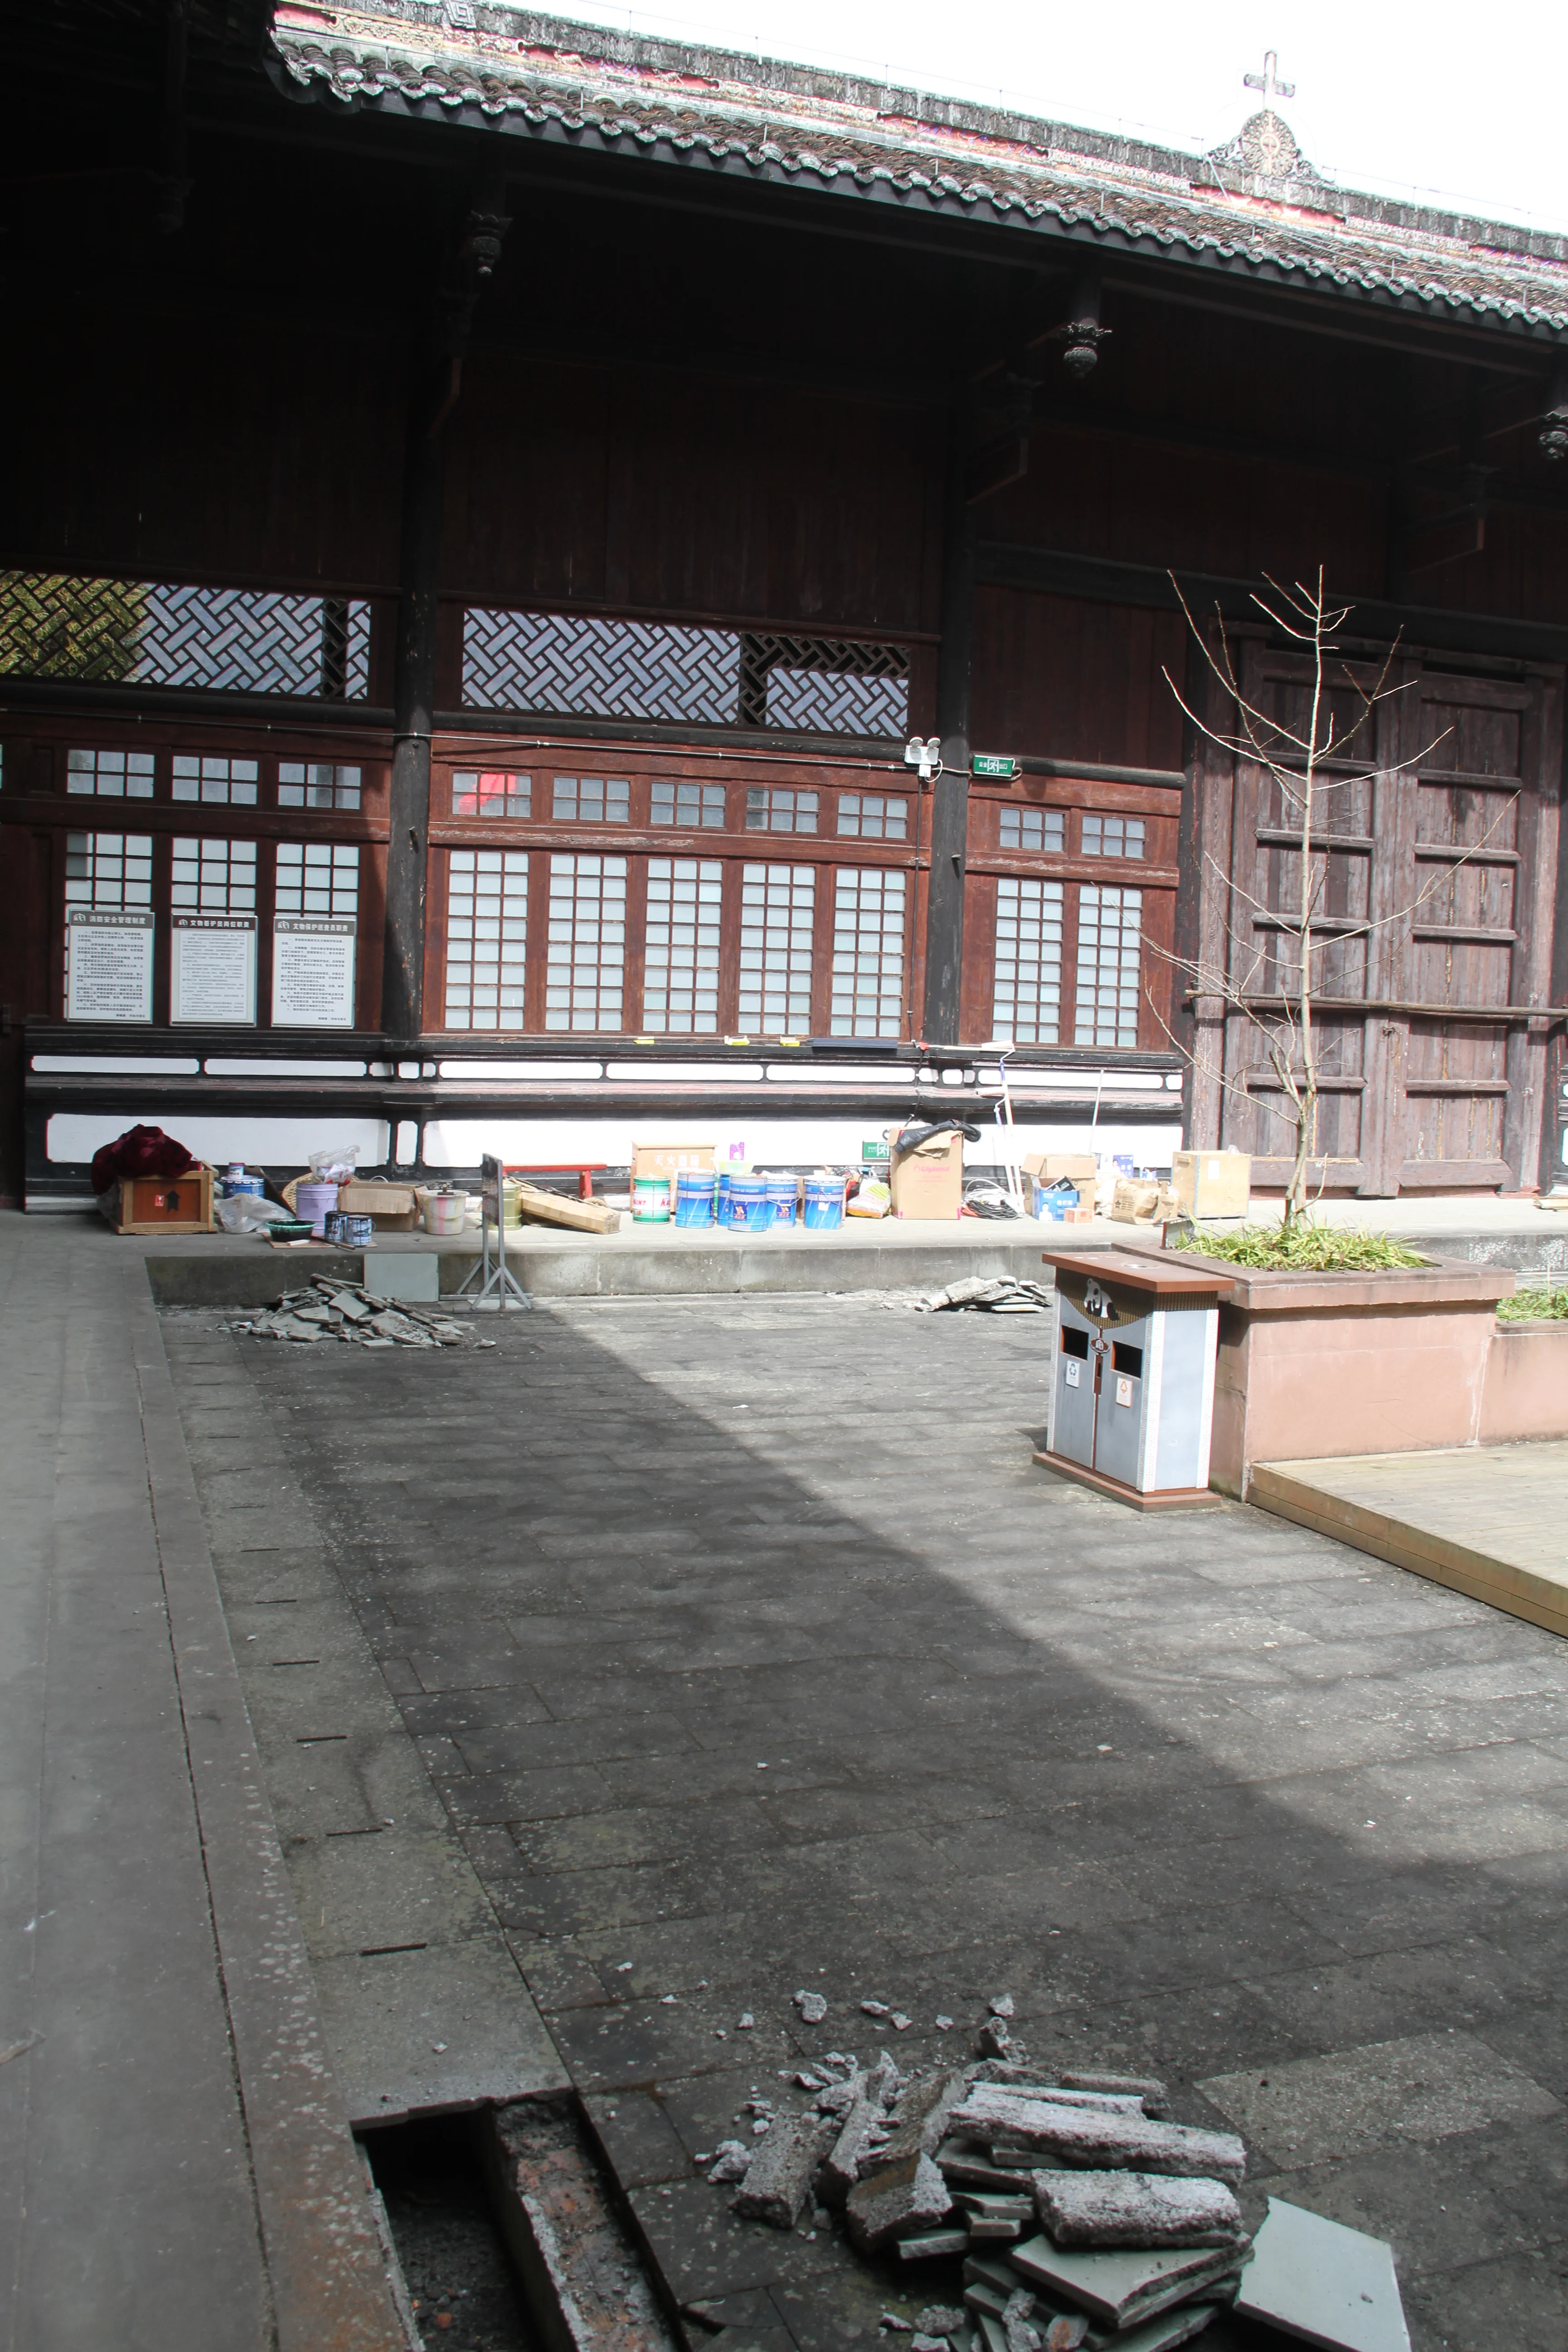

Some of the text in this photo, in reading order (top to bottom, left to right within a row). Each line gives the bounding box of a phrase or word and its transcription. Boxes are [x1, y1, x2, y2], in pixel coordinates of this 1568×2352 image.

[89, 915, 146, 925] 消防安全管理制度
[190, 920, 250, 928] 文物看护员岗位职责
[293, 923, 349, 932] 文物保护巡查员职责
[654, 1155, 700, 1167] 灭火器箱
